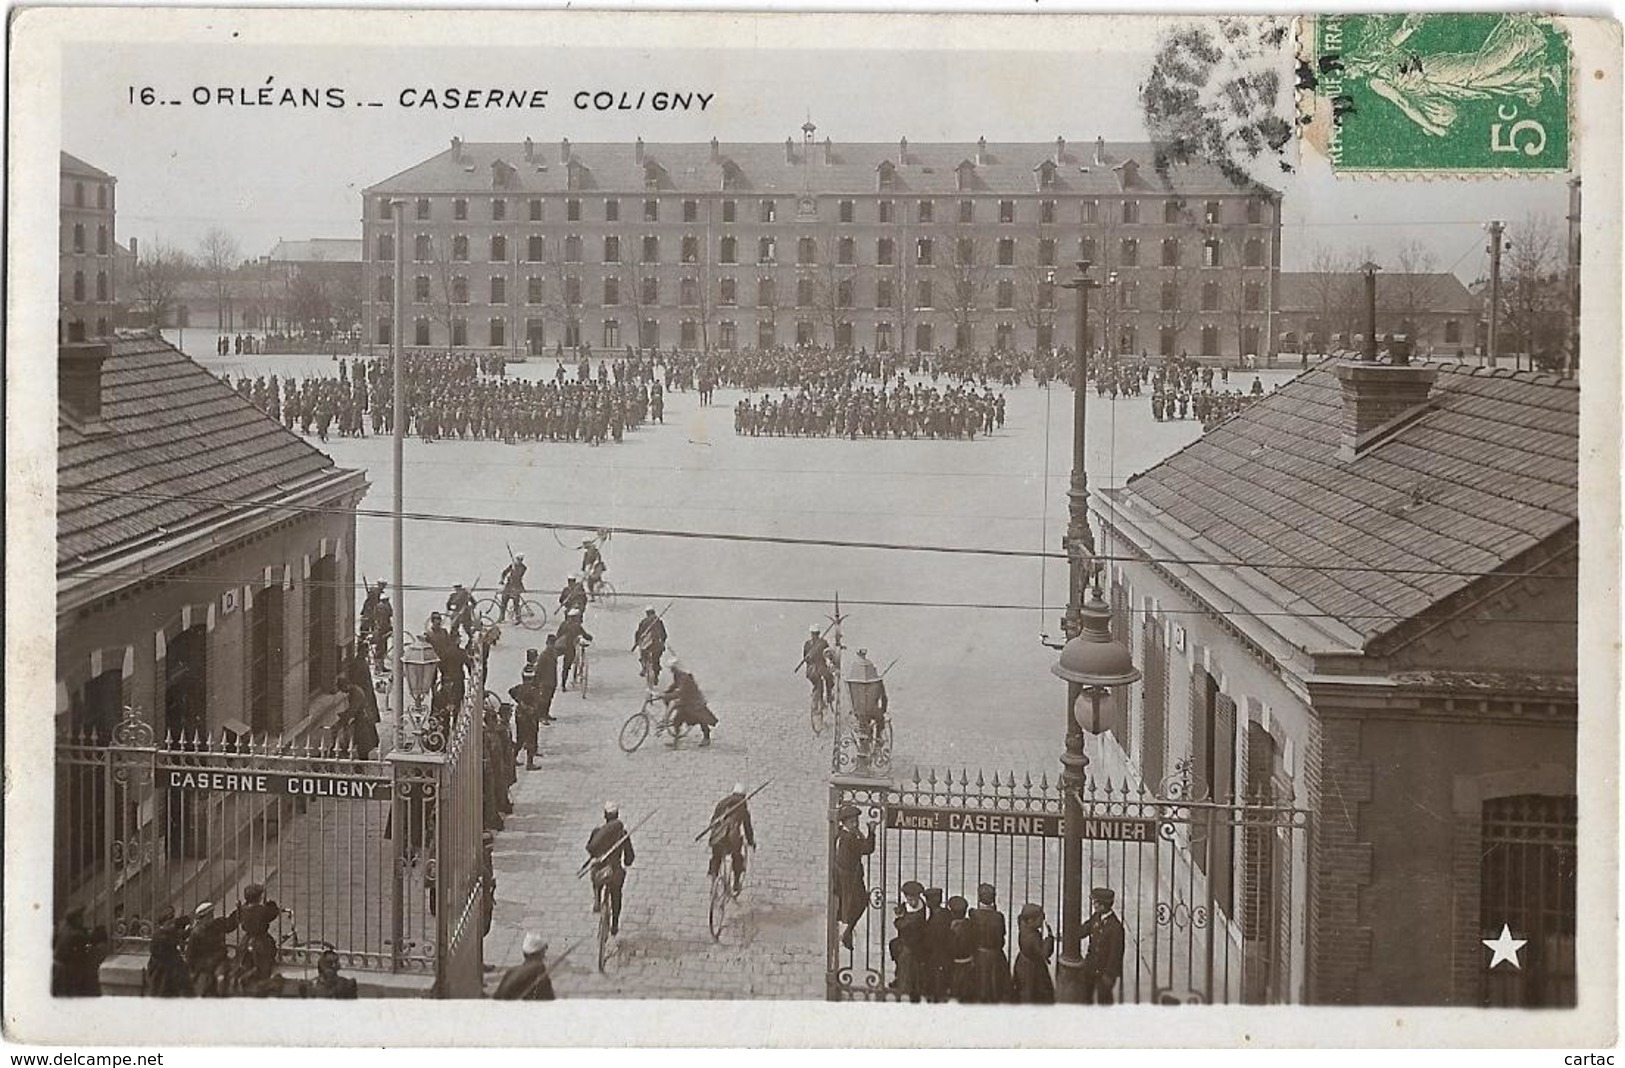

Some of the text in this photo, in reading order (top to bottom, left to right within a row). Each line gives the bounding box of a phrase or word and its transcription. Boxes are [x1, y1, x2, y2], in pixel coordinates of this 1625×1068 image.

[170, 772, 378, 798] CASERNE COLIGNY
[949, 813, 1044, 834] CASERNE
[1057, 819, 1146, 840] BNNIER
